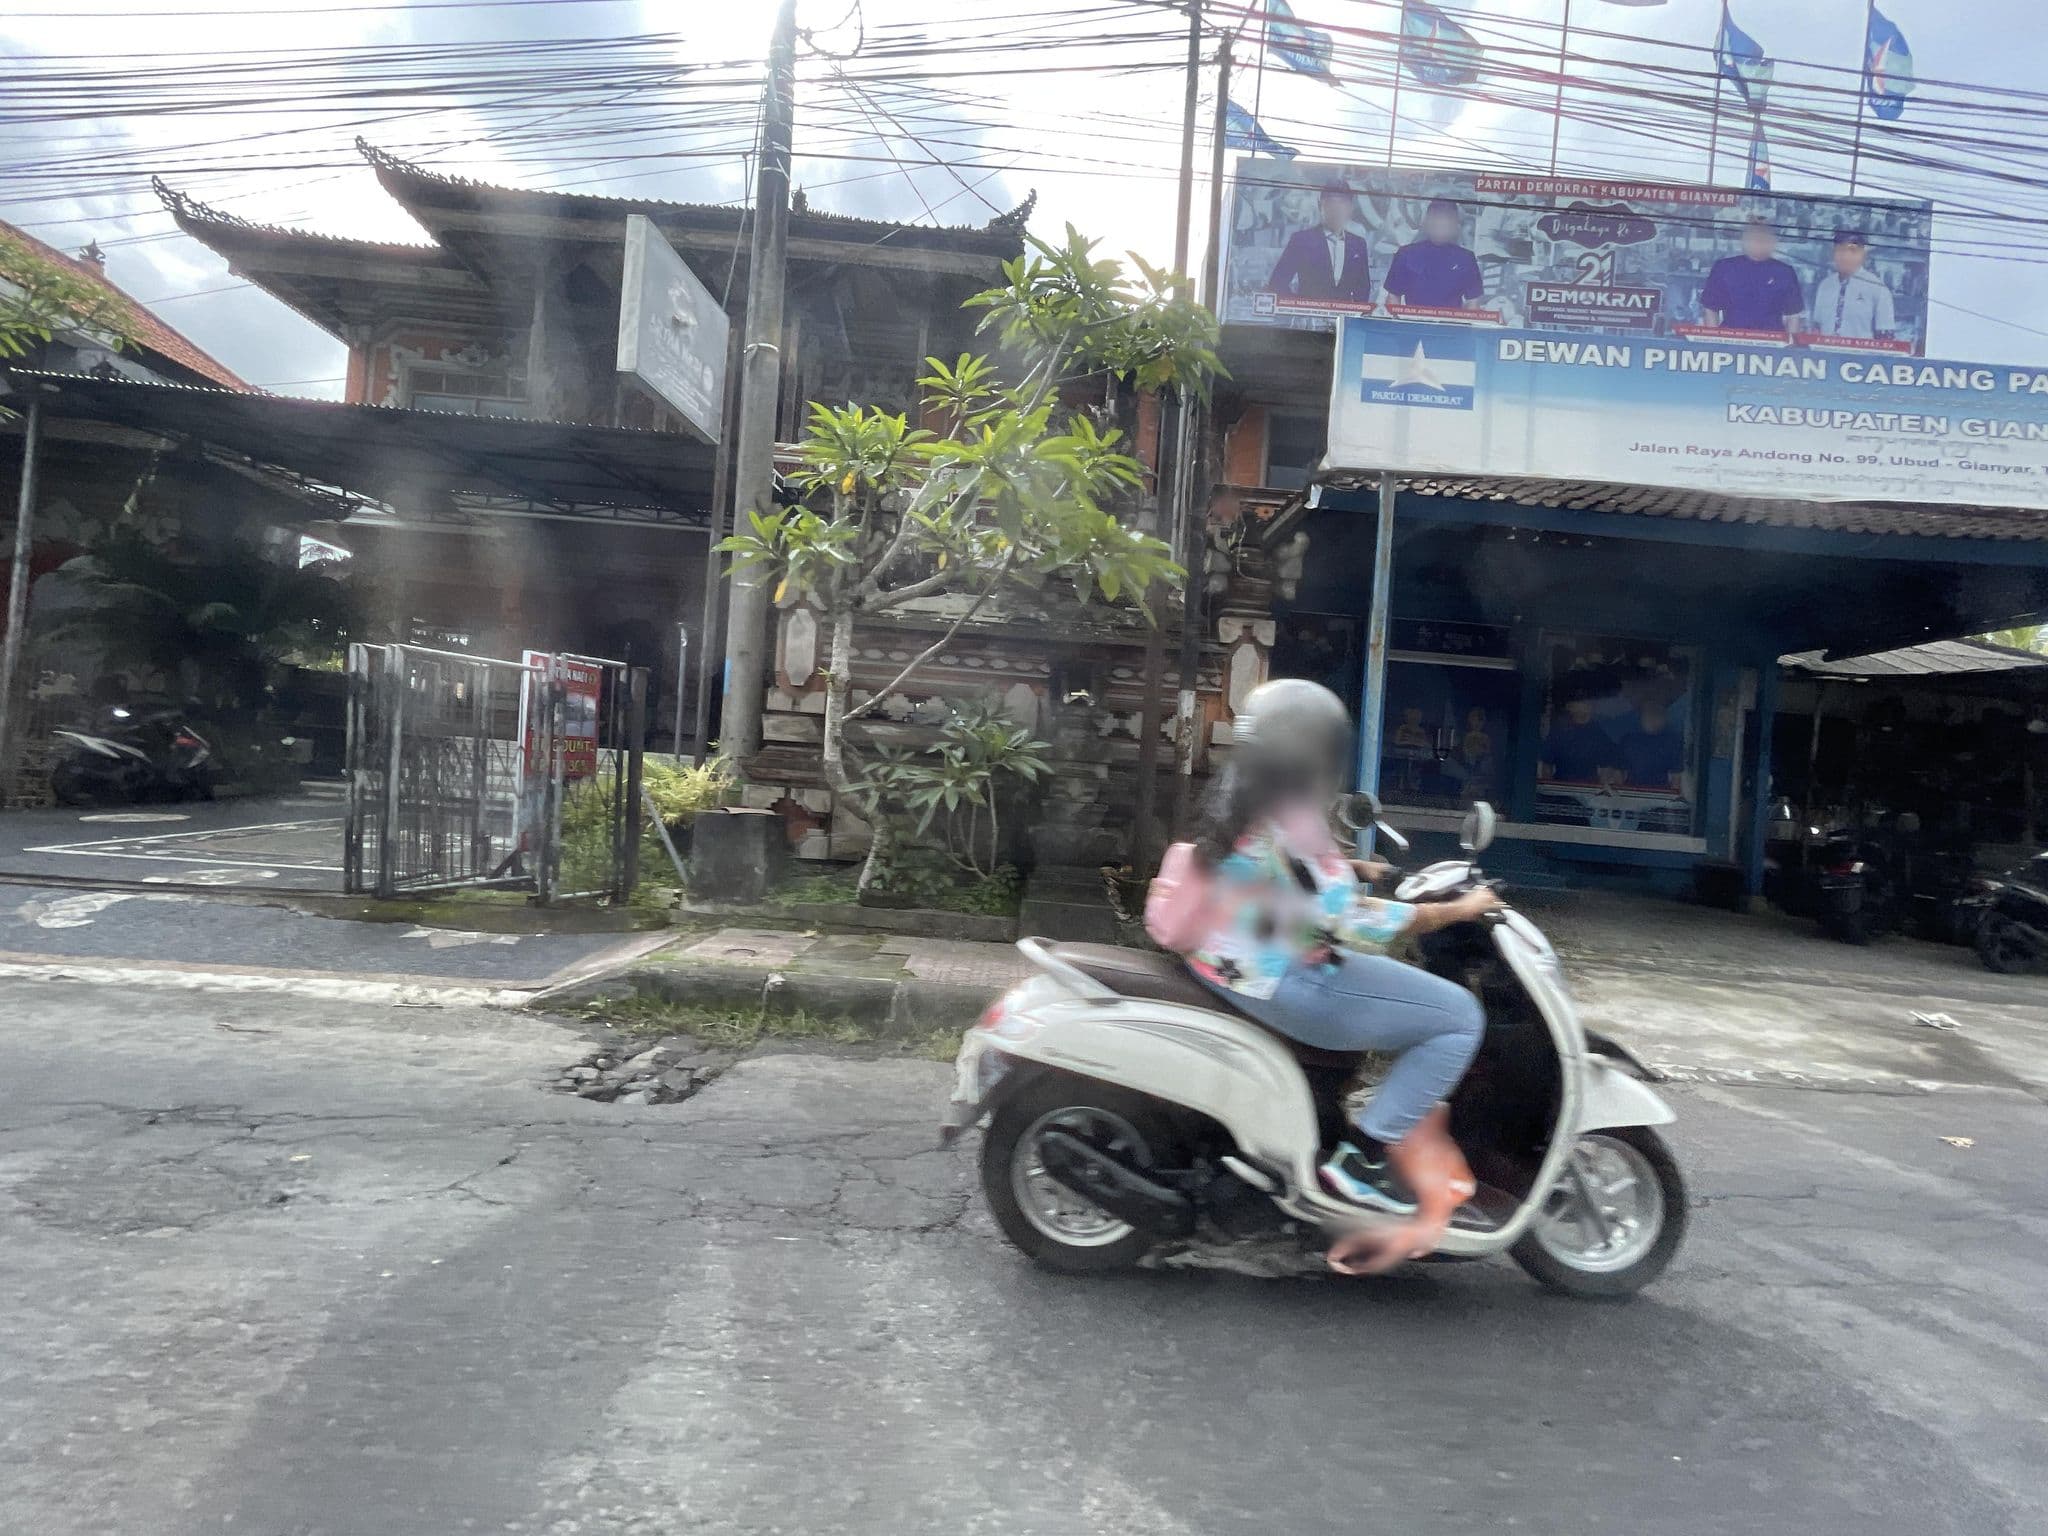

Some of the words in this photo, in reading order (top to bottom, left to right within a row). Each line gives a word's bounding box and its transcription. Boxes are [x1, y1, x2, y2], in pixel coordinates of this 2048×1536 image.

[1476, 177, 1522, 193] PARTAI
[1526, 180, 1598, 197] DEMOKRAT
[1601, 185, 1676, 201] KABUPATEN
[1680, 190, 1735, 205] GIANYAR
[1579, 257, 1615, 288] 21
[1531, 289, 1656, 309] DEMOKRAT
[1499, 338, 1631, 369] DEWAN
[1644, 348, 1829, 381] PIMPINAN
[1839, 361, 1997, 393] CABANG
[1371, 390, 1404, 402] PARTAI
[1407, 393, 1464, 407] DEMOKRAT
[1727, 404, 1949, 435] KABUPATEN
[1628, 442, 1680, 456] Jalan
[1685, 444, 1733, 460] Raya
[1740, 448, 1813, 465] Andong
[1819, 453, 1850, 465] No.
[1857, 455, 1883, 468] 99,
[1890, 456, 1940, 469] Ubud
[1958, 460, 2035, 477] Gianyar,
